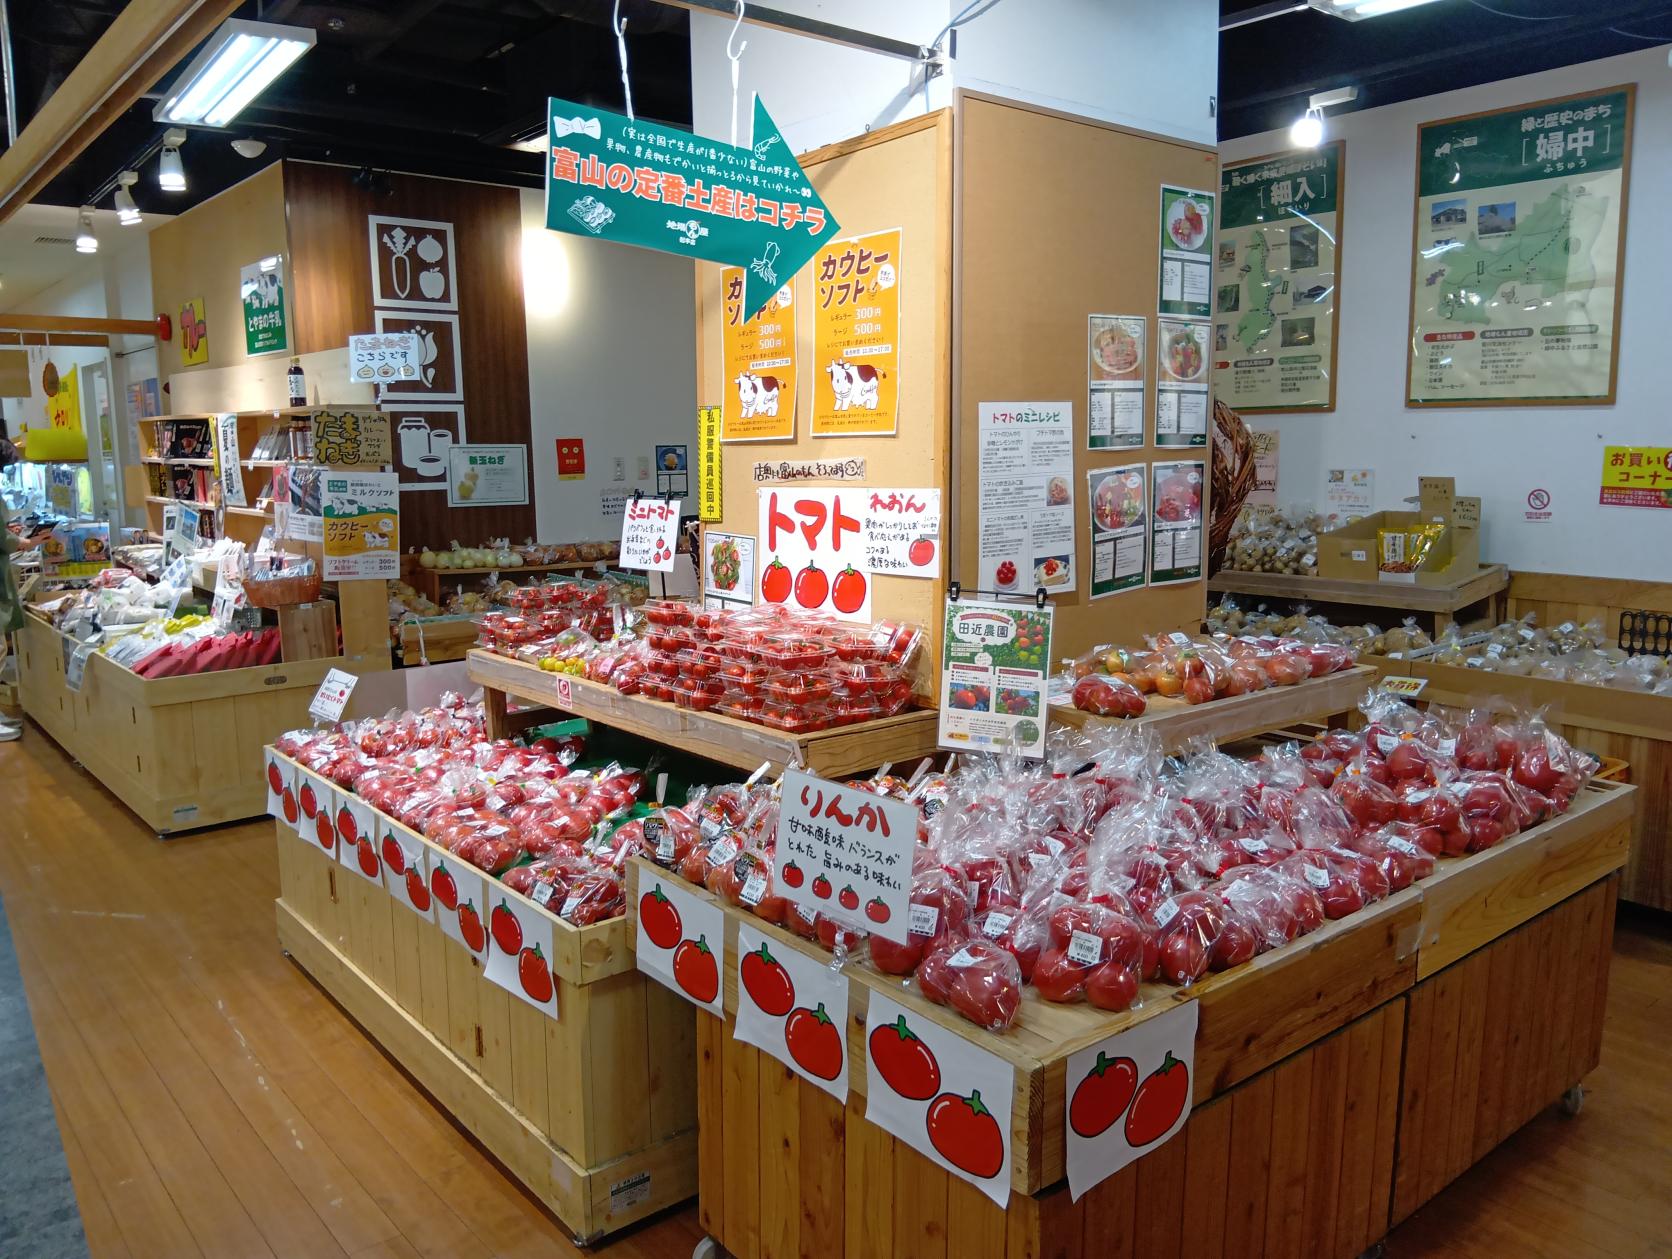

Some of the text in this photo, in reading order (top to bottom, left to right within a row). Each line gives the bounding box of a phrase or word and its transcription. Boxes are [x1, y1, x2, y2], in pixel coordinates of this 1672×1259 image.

[1520, 104, 1612, 133] 緑と歴史のまち
[1536, 127, 1596, 163] 婦中
[1543, 158, 1588, 174] ふちゅう
[551, 146, 828, 236] 富山の定番土産はコチラ
[1270, 177, 1316, 207] 細入
[819, 248, 890, 283] カウヒー
[819, 279, 866, 310] ソフト
[247, 310, 283, 333] とやまの牛乳
[855, 306, 882, 321] 300円
[854, 321, 882, 337] 500円
[356, 350, 409, 364] こちらです
[993, 411, 1061, 424] トマトのミニレシピ
[351, 488, 395, 497] ミルクソフト
[869, 492, 927, 514] れおん
[628, 500, 675, 521] ミニトマト
[328, 521, 369, 532] カウヒー
[767, 491, 861, 553] トマト
[329, 532, 355, 542] ソフト
[958, 622, 1009, 639] 田近農園
[800, 784, 892, 838] りんか
[788, 837, 817, 860] とれた
